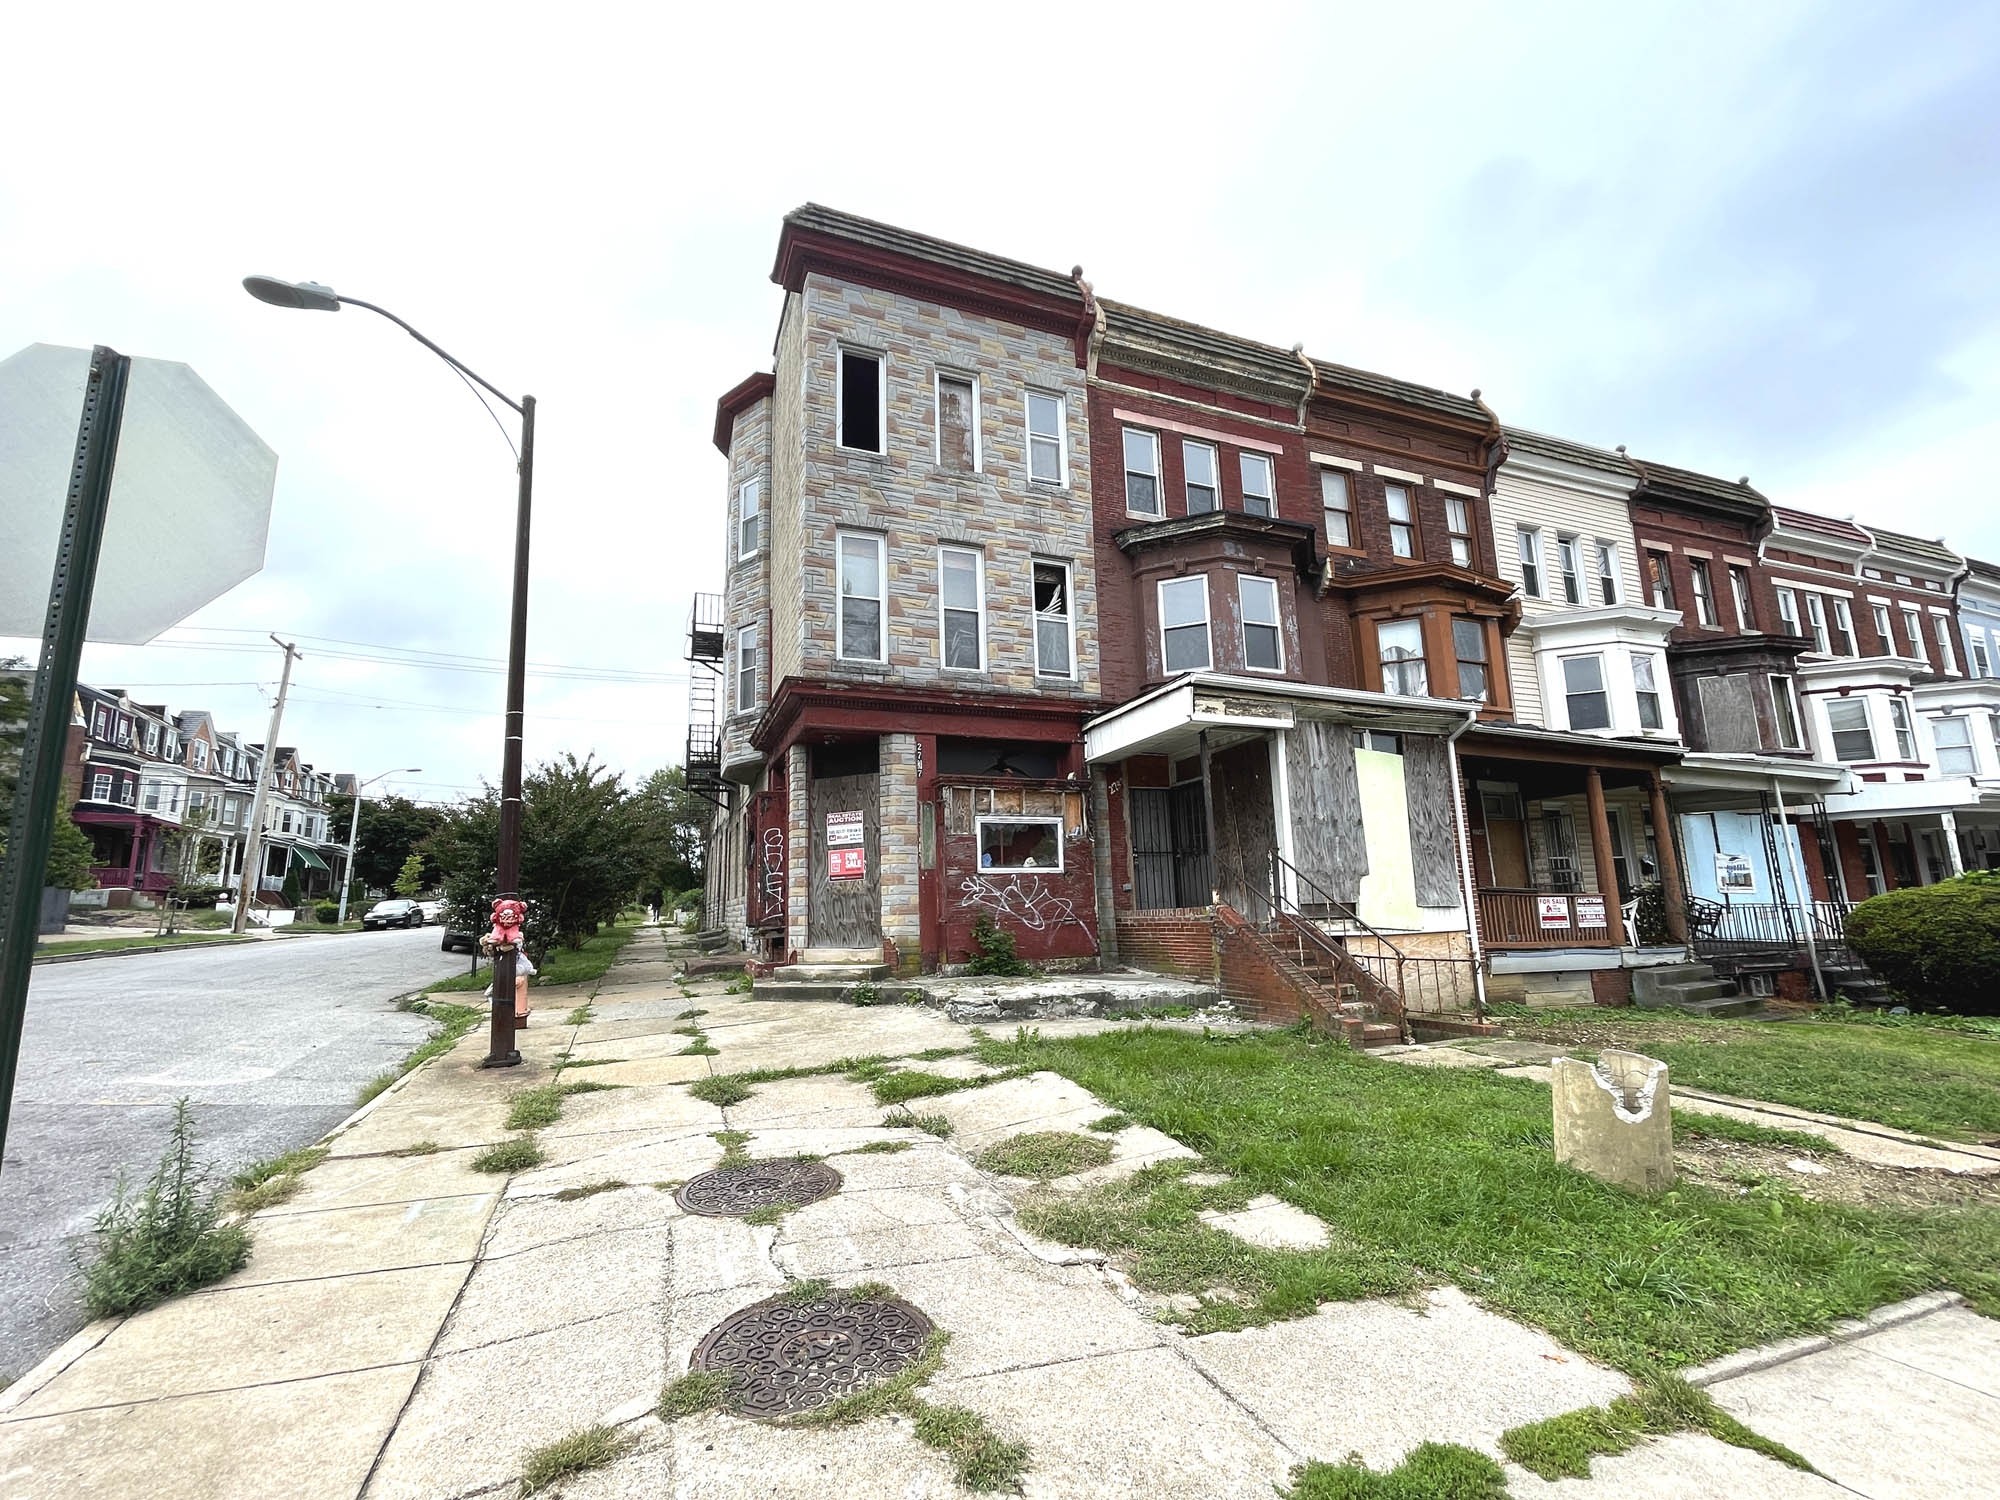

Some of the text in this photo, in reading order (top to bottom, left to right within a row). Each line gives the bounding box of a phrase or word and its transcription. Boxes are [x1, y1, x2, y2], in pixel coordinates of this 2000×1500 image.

[828, 816, 862, 824] AUCTION
[845, 852, 858, 860] FOR
[845, 859, 862, 868] SALE
